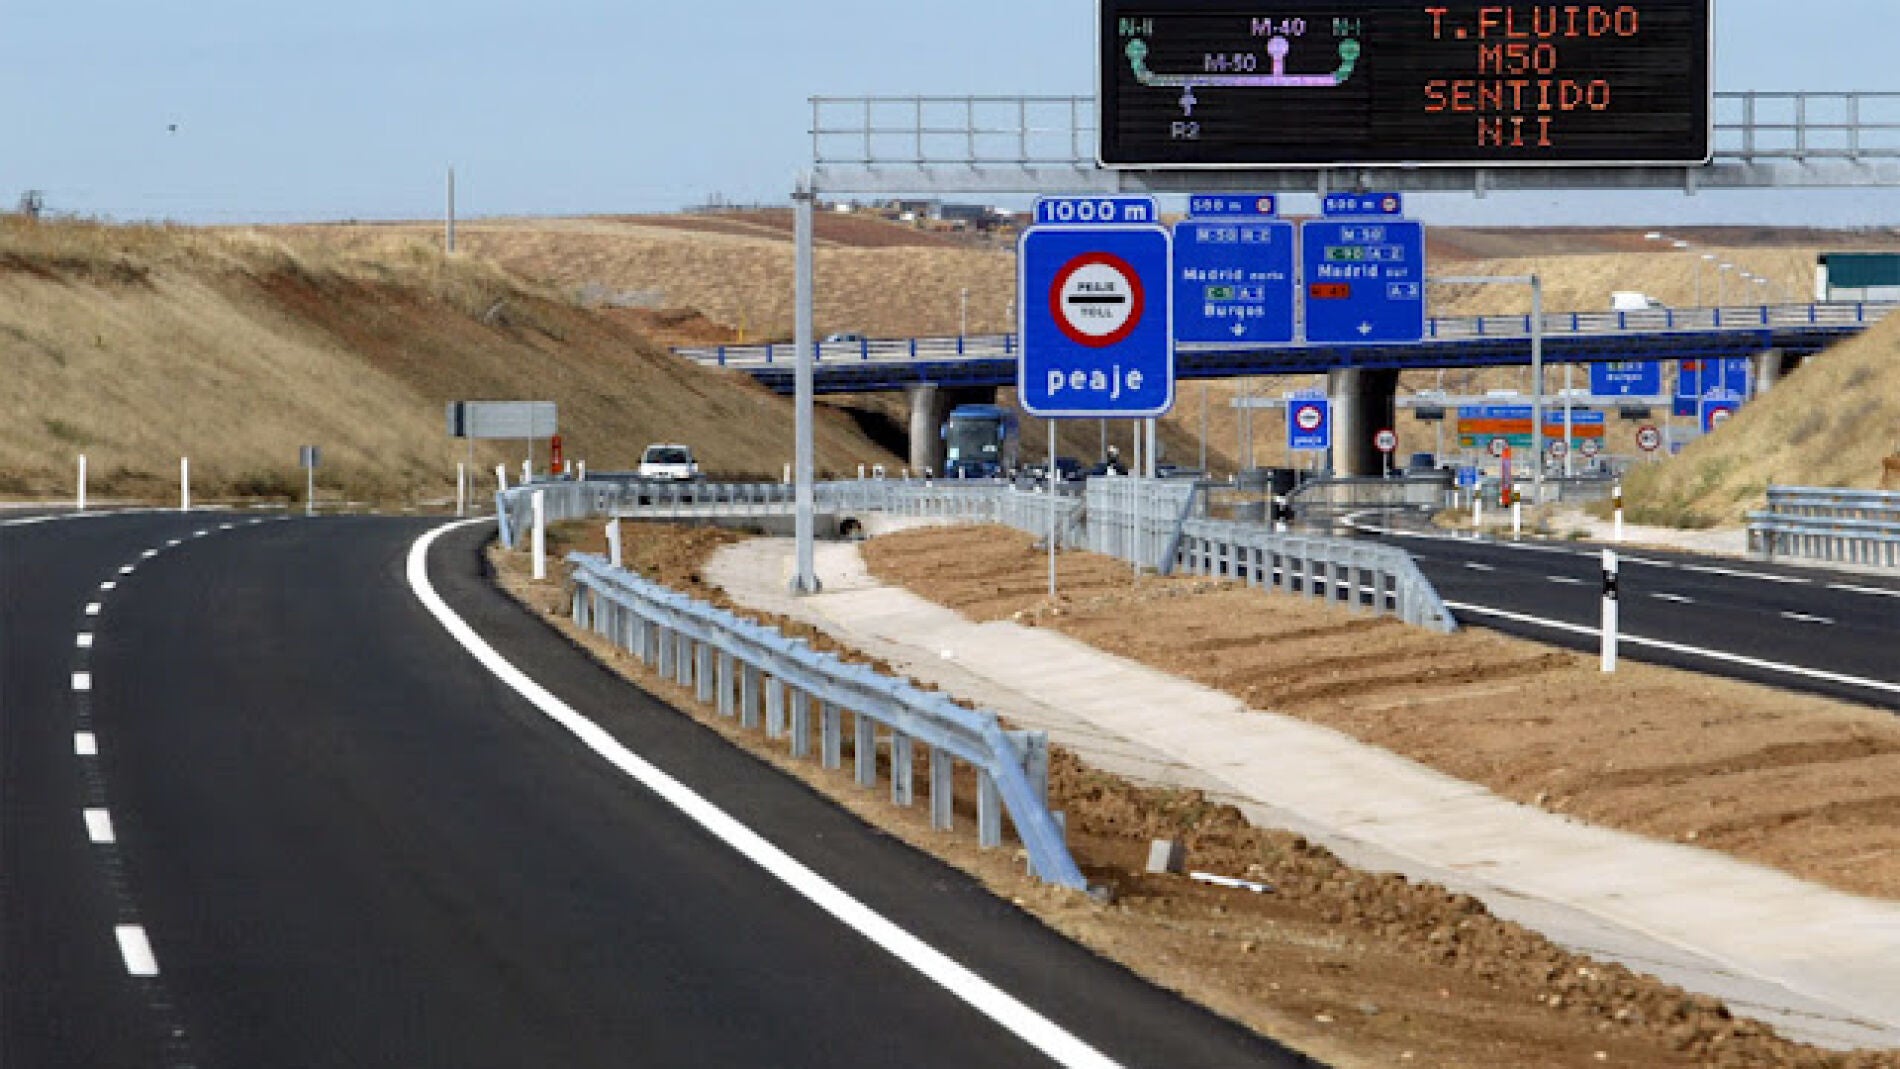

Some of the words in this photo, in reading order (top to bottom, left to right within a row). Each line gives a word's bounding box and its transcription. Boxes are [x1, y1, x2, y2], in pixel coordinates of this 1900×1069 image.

[1250, 17, 1306, 36] M-40
[1424, 5, 1639, 39] T.FLUIDO
[1204, 53, 1257, 72] M-50
[1478, 44, 1556, 74] M50
[1424, 80, 1610, 111] SENTIDO
[1170, 121, 1200, 140] R2
[1478, 116, 1552, 146] NII
[1044, 201, 1116, 221] 1000
[1124, 204, 1147, 221] m
[1183, 267, 1242, 280] Madrid
[1317, 263, 1379, 278] Madrid
[1077, 281, 1114, 292] PEAJE
[1080, 308, 1114, 318] TOLL
[1204, 303, 1265, 320] Burgos
[1047, 364, 1143, 399] peaje
